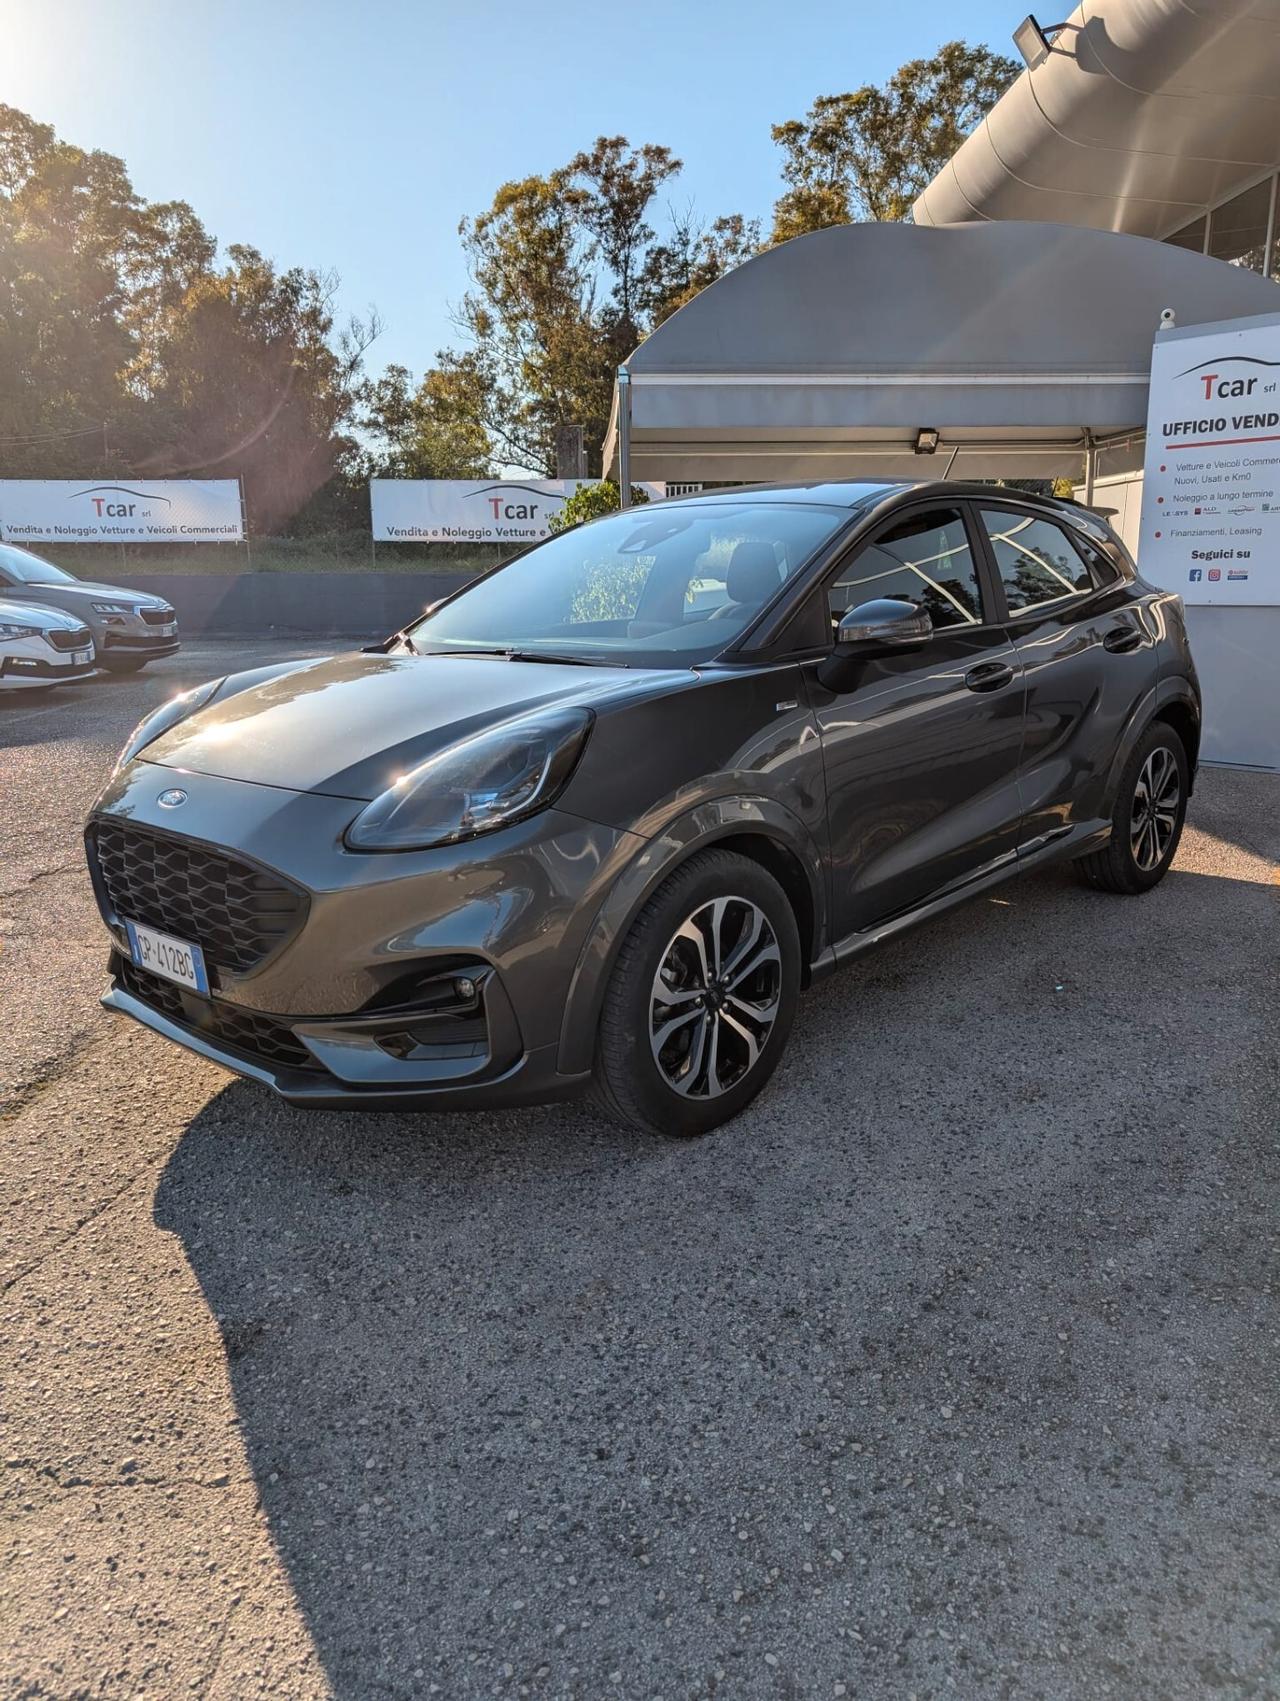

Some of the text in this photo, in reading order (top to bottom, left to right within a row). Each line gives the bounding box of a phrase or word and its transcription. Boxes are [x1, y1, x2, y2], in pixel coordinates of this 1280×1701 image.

[1200, 374, 1277, 400] Tcar srl
[1162, 413, 1280, 437] UFFICIO VEND
[1176, 463, 1205, 473] Vetture
[1214, 459, 1241, 469] Veicoli
[1242, 457, 1280, 467] Commer
[1201, 474, 1222, 484] Usati
[1173, 494, 1208, 504] Noleggio
[1217, 492, 1240, 501] lungo
[1242, 490, 1274, 499] termine
[91, 498, 136, 518] Tcar
[488, 497, 538, 520] Tcar
[6, 524, 43, 534] Vendita
[54, 524, 98, 537] Noleggio
[100, 525, 136, 534] Vetture
[146, 525, 178, 534] Veicoli
[180, 524, 238, 534] Commerciali
[386, 526, 429, 537] Vendita
[431, 529, 438, 537] e
[442, 526, 492, 539] Noleggio
[495, 527, 536, 537] Vetture
[539, 529, 546, 537] e
[1229, 526, 1263, 537] Leasing
[1191, 549, 1251, 561] Seguici su
